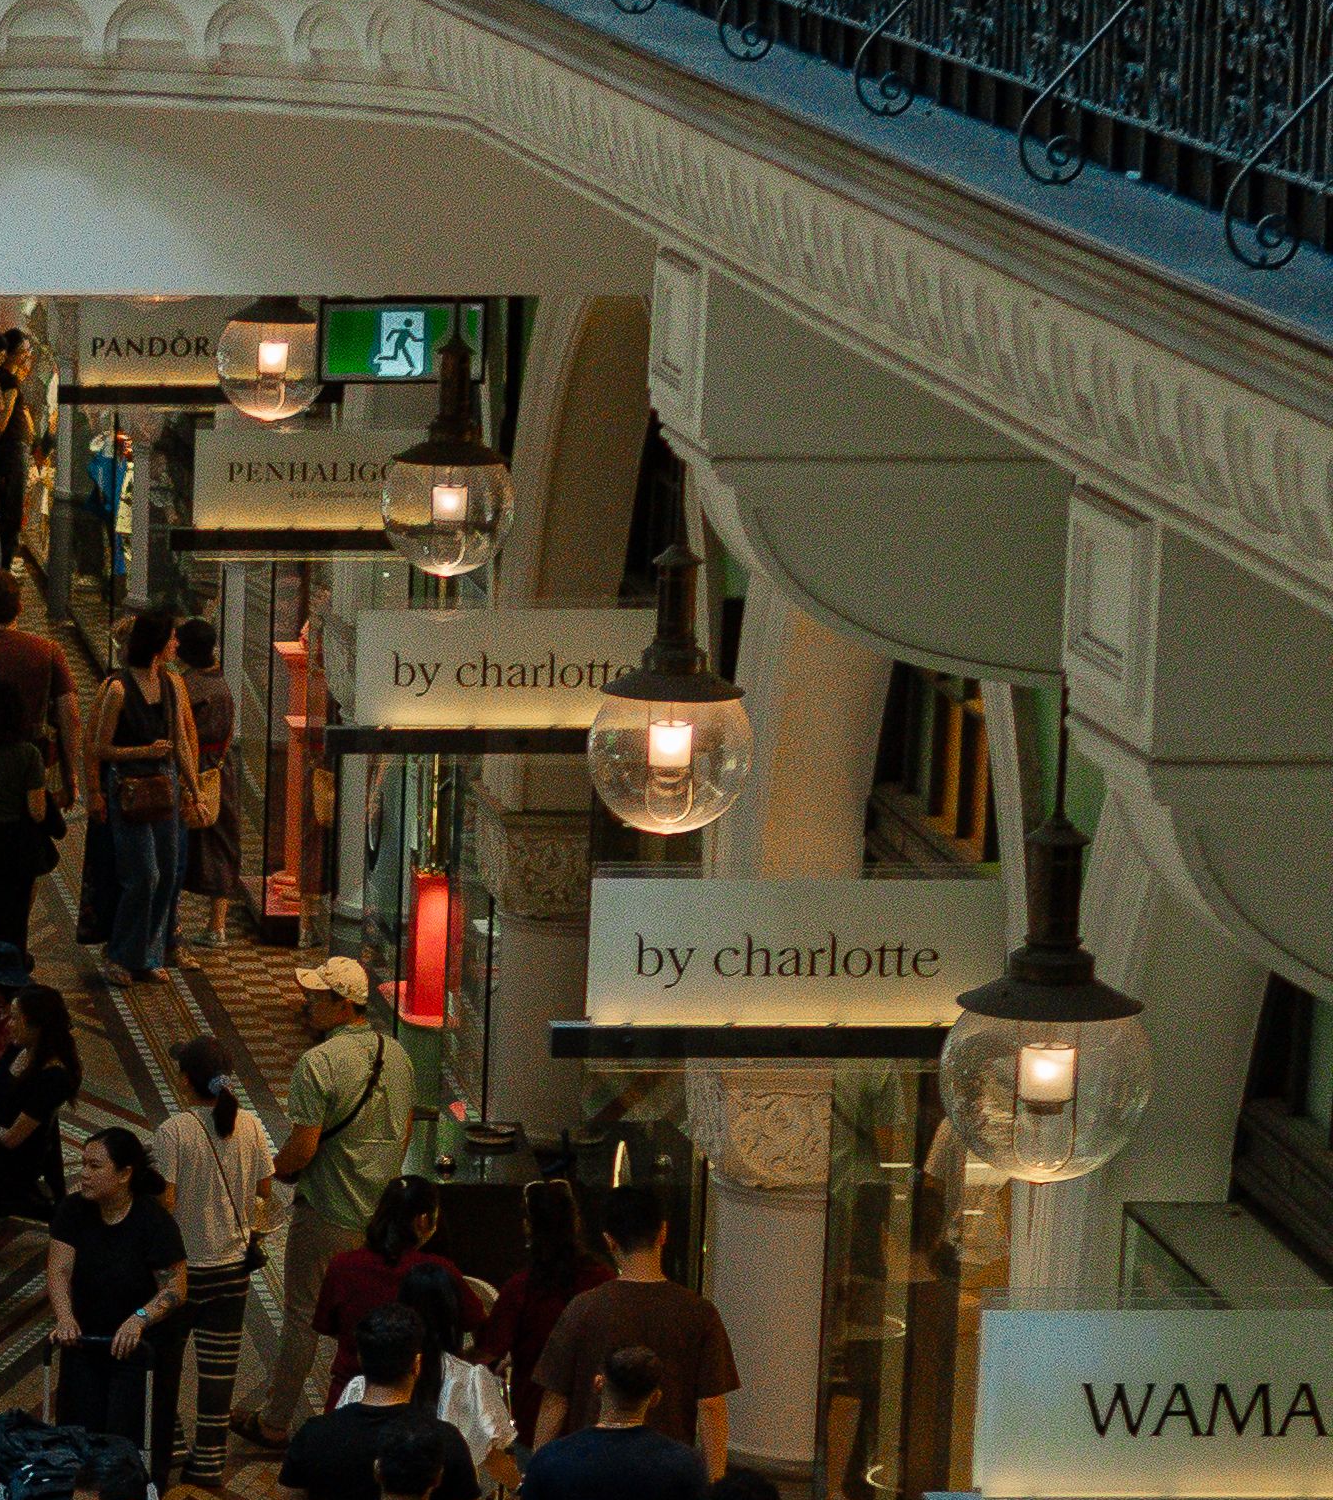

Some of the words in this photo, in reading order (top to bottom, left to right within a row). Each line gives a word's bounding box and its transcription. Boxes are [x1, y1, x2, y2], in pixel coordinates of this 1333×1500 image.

[91, 331, 217, 358] PANDOR
[390, 649, 441, 698] by
[635, 933, 696, 989] by
[713, 932, 941, 979] charlotte
[1084, 1382, 1333, 1438] WAMA
